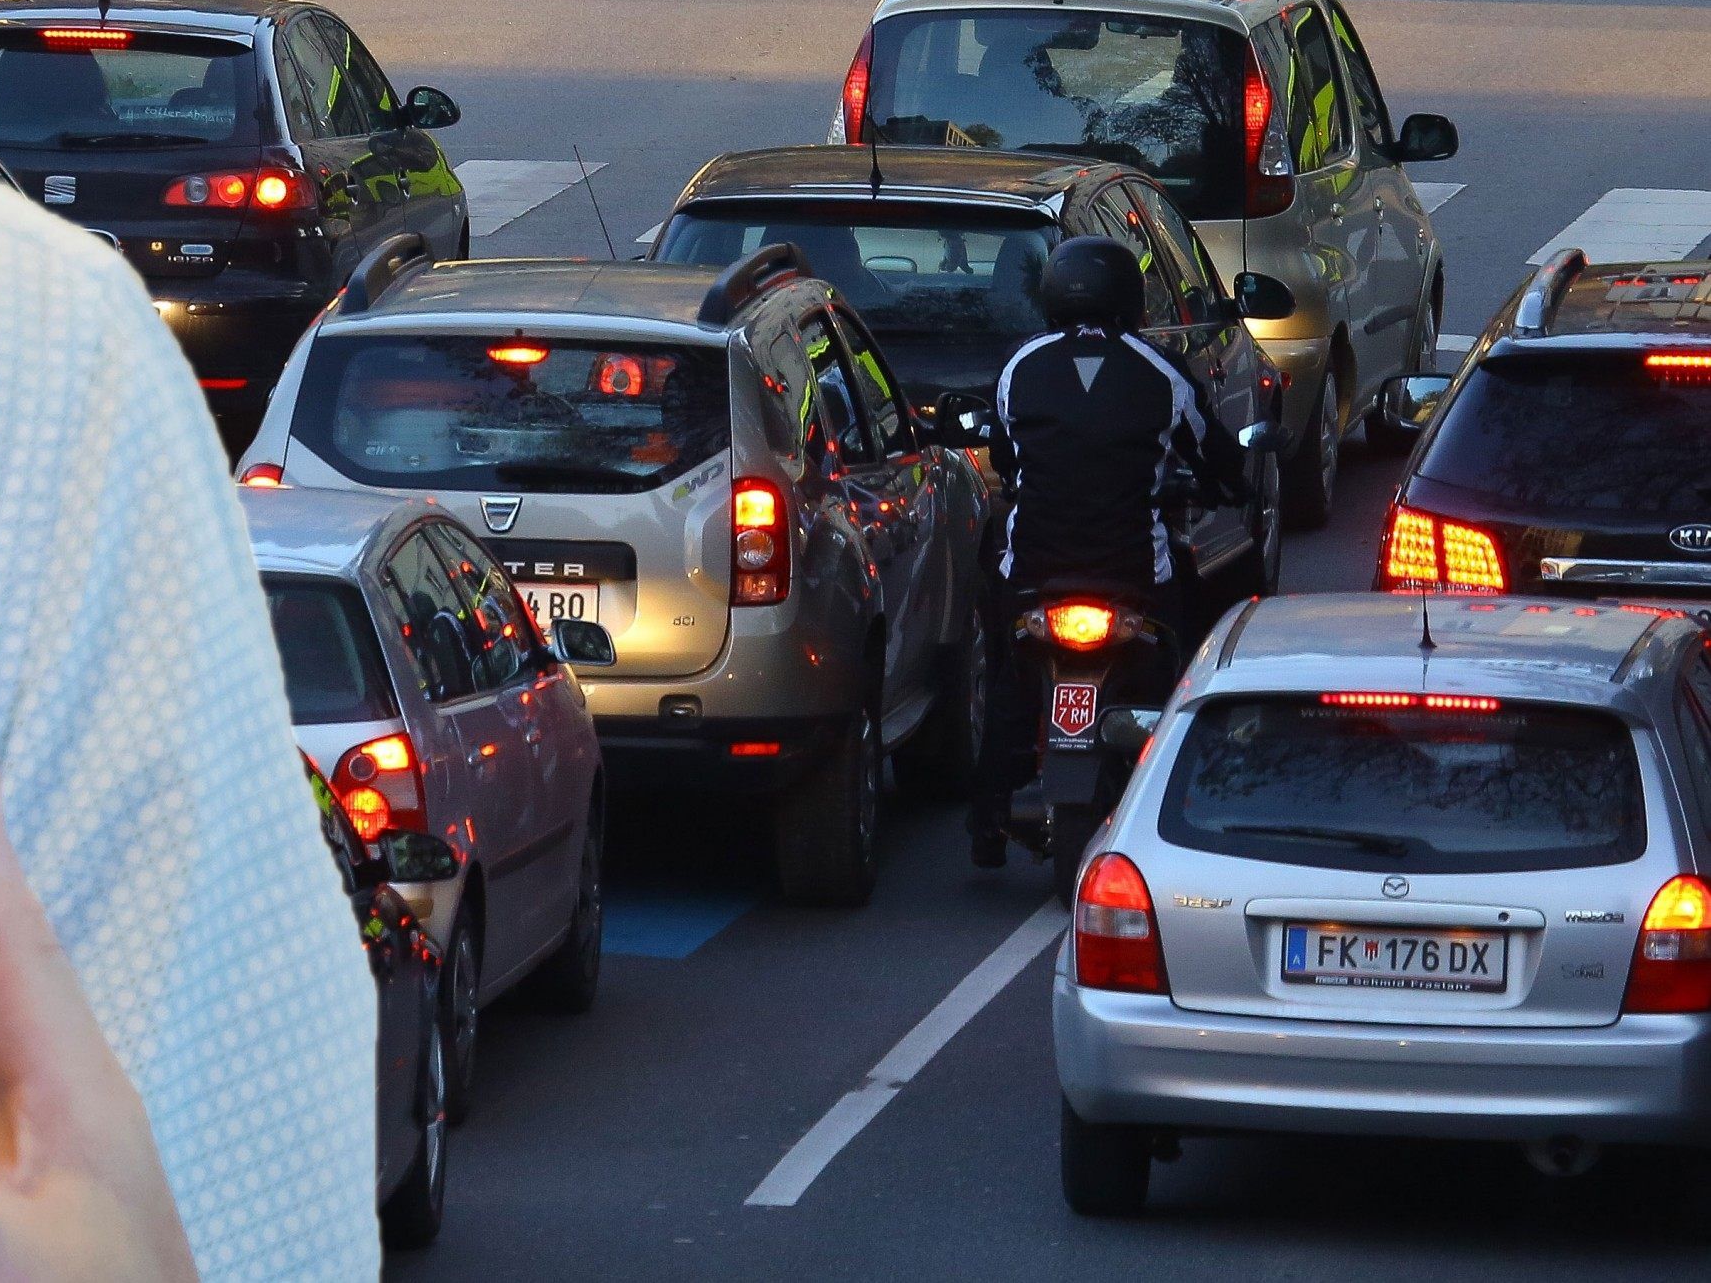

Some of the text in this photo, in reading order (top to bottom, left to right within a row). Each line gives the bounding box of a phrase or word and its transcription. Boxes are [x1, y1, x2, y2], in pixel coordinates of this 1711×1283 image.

[503, 562, 585, 577] TER
[549, 592, 585, 621] BO
[1058, 707, 1089, 724] 7 RM
[1317, 935, 1490, 975] FK 176 DX
[1353, 977, 1405, 989] Schmid
